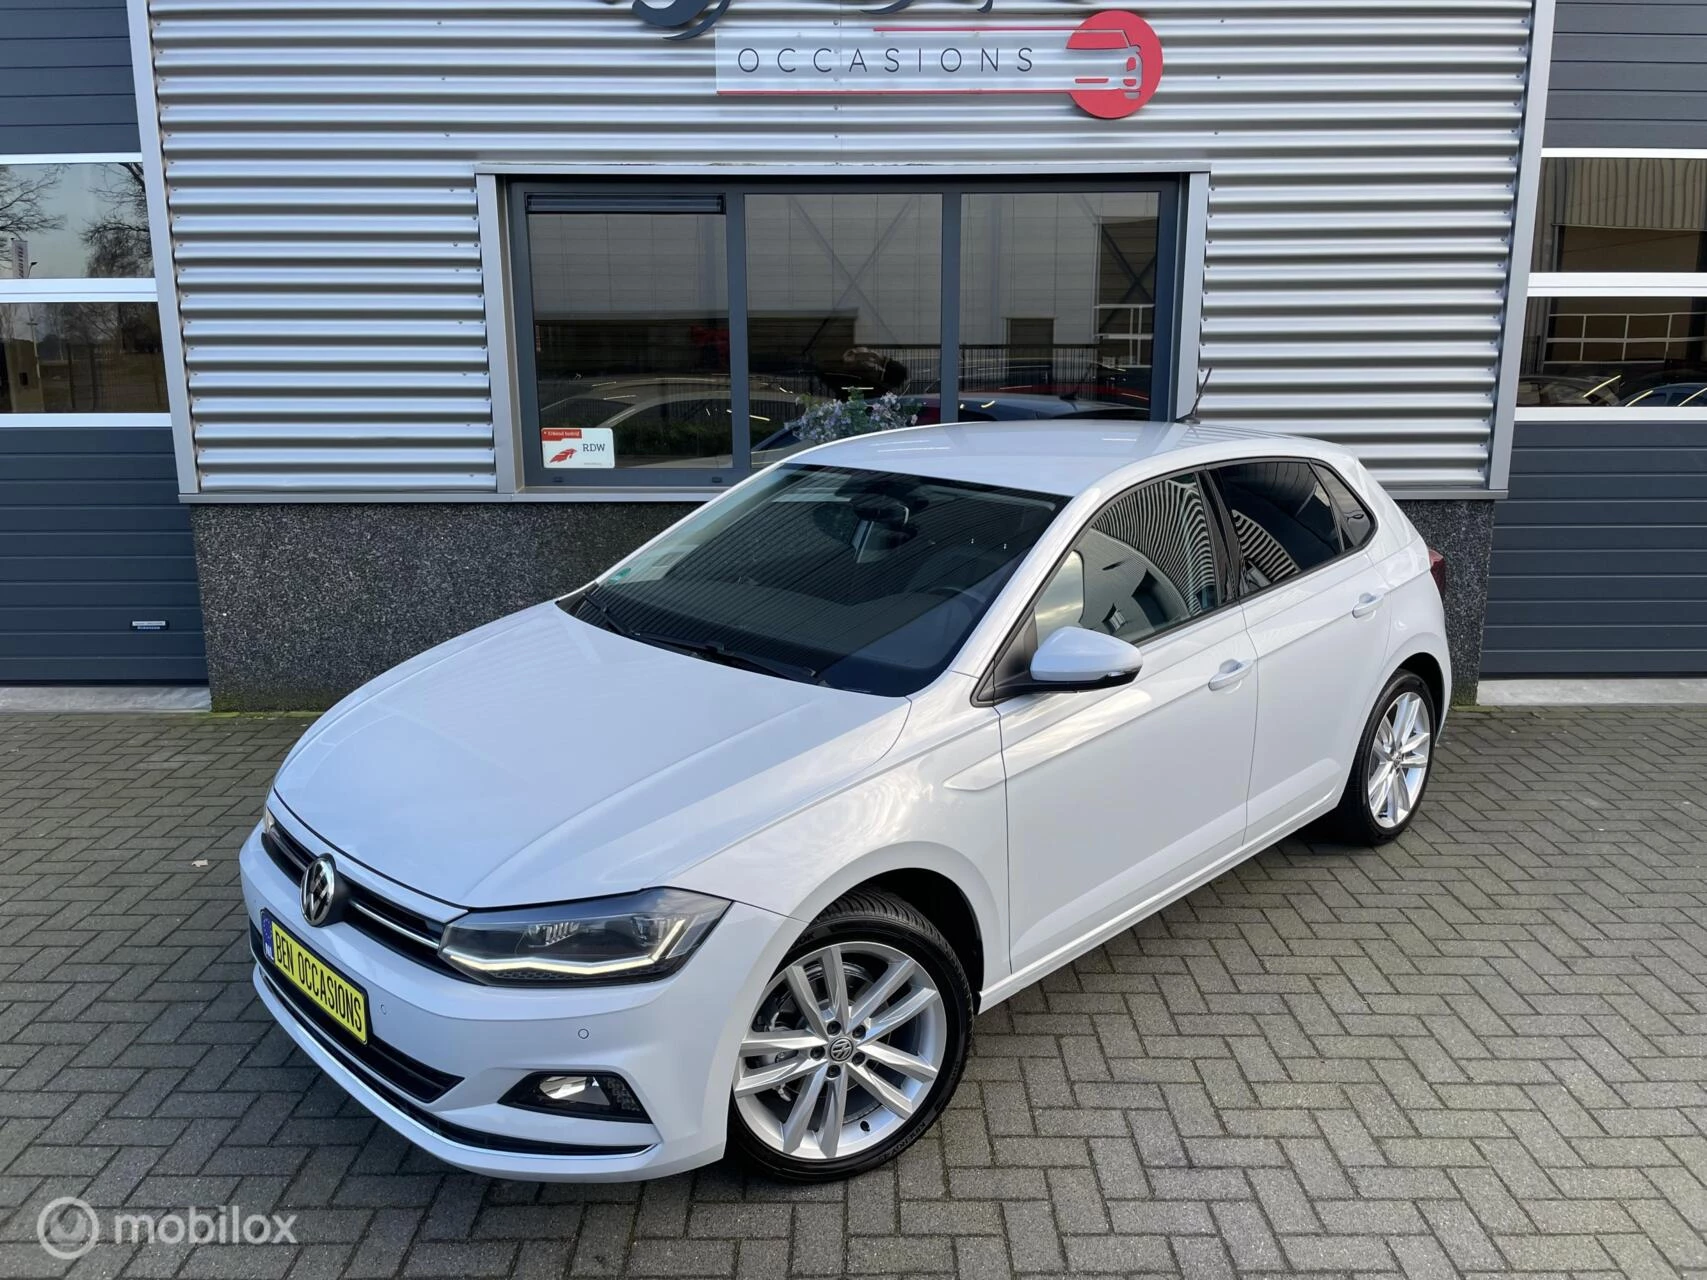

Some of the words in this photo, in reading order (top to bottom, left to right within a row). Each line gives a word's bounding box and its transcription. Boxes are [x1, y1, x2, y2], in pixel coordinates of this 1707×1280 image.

[737, 46, 1034, 73] OCCASIONS
[582, 443, 606, 452] RDW
[275, 931, 294, 976] BEN
[297, 951, 362, 1033] OCCASIONS
